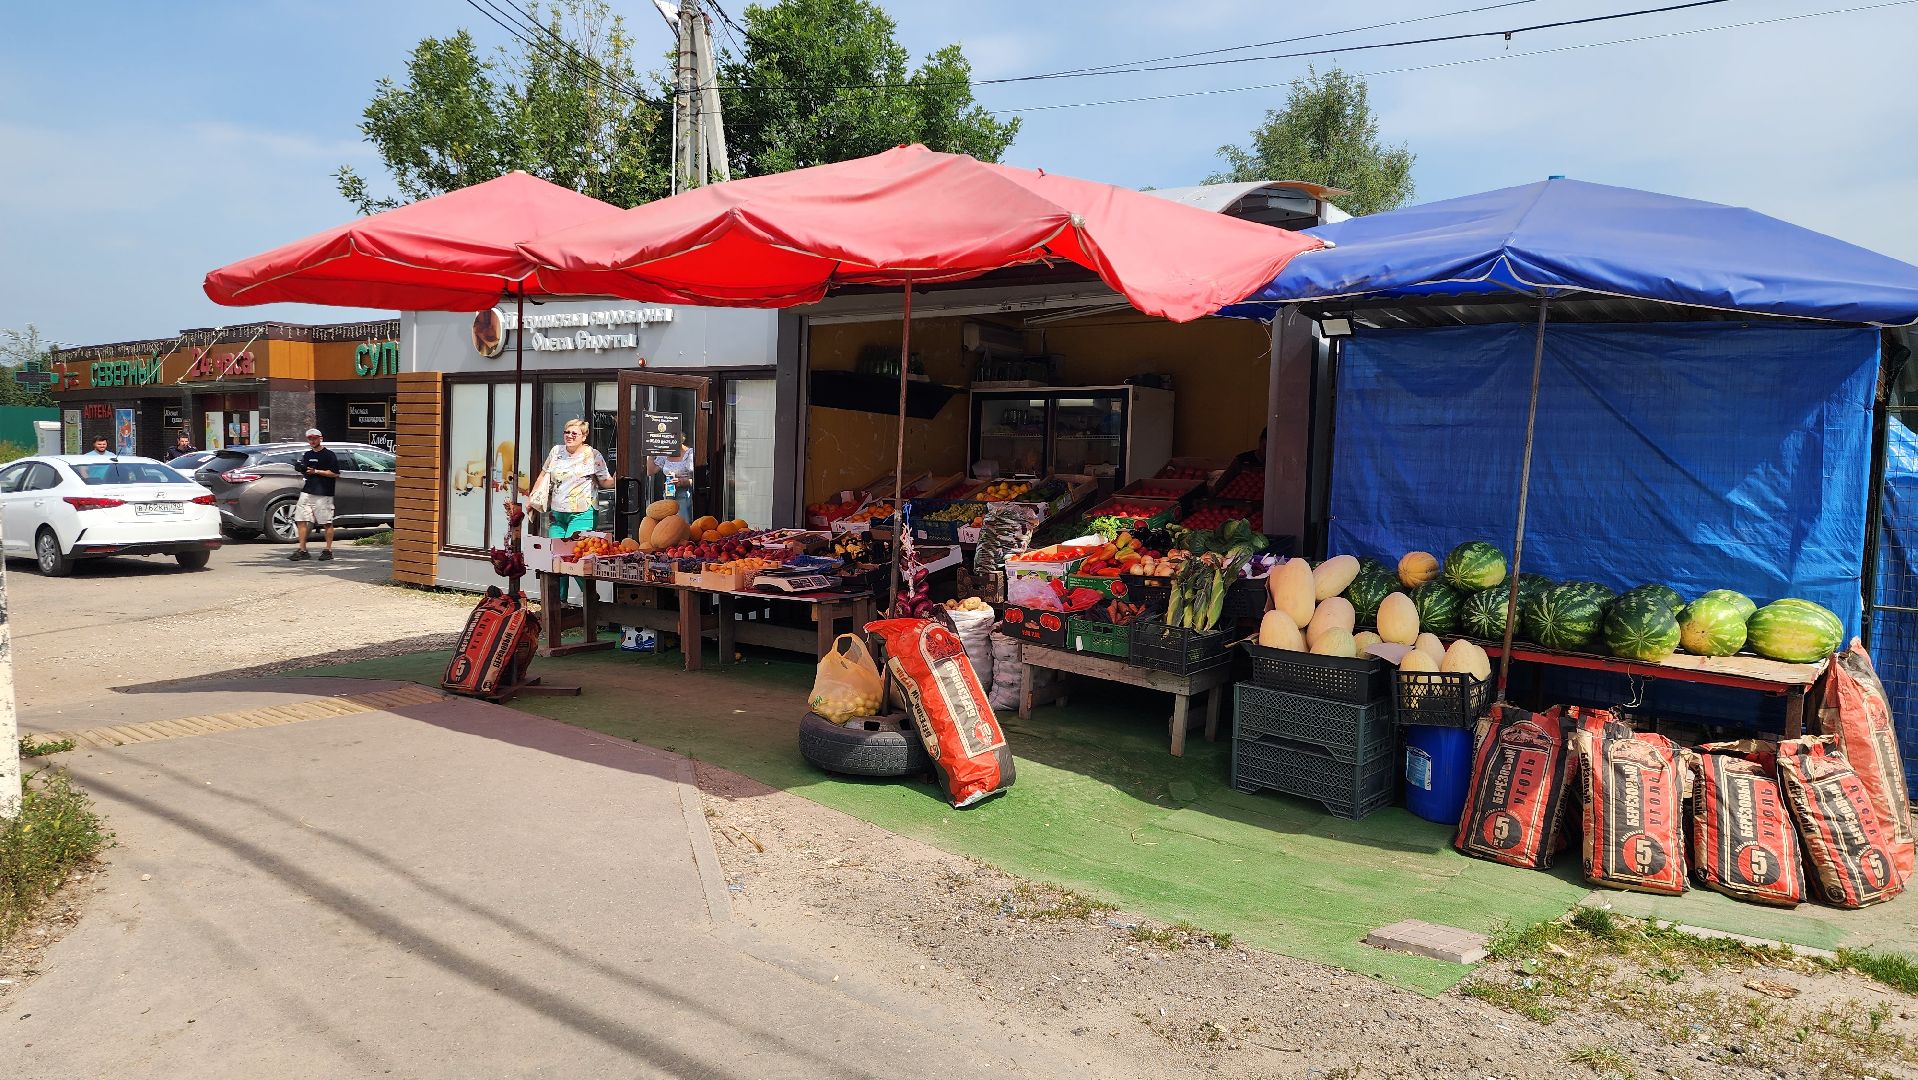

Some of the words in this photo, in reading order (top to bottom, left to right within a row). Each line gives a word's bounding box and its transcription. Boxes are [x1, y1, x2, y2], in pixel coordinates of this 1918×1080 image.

[90, 351, 161, 388] СЕВЕРНЫЙ
[355, 342, 400, 376] СУП
[84, 404, 113, 420] АПТЕКА
[371, 434, 387, 445] Хлеб
[470, 617, 491, 650] УГОЛЬ
[457, 659, 467, 677] 5
[1514, 759, 1536, 805] УГОЛЬ
[1649, 777, 1661, 825] УГОЛЬ
[1761, 788, 1775, 837] УГОЛЬ
[1850, 785, 1877, 835] УГОЛЬ
[1494, 815, 1510, 839] 5
[1636, 839, 1652, 864] 5
[1751, 849, 1768, 875] 5
[1870, 853, 1884, 879] 5
